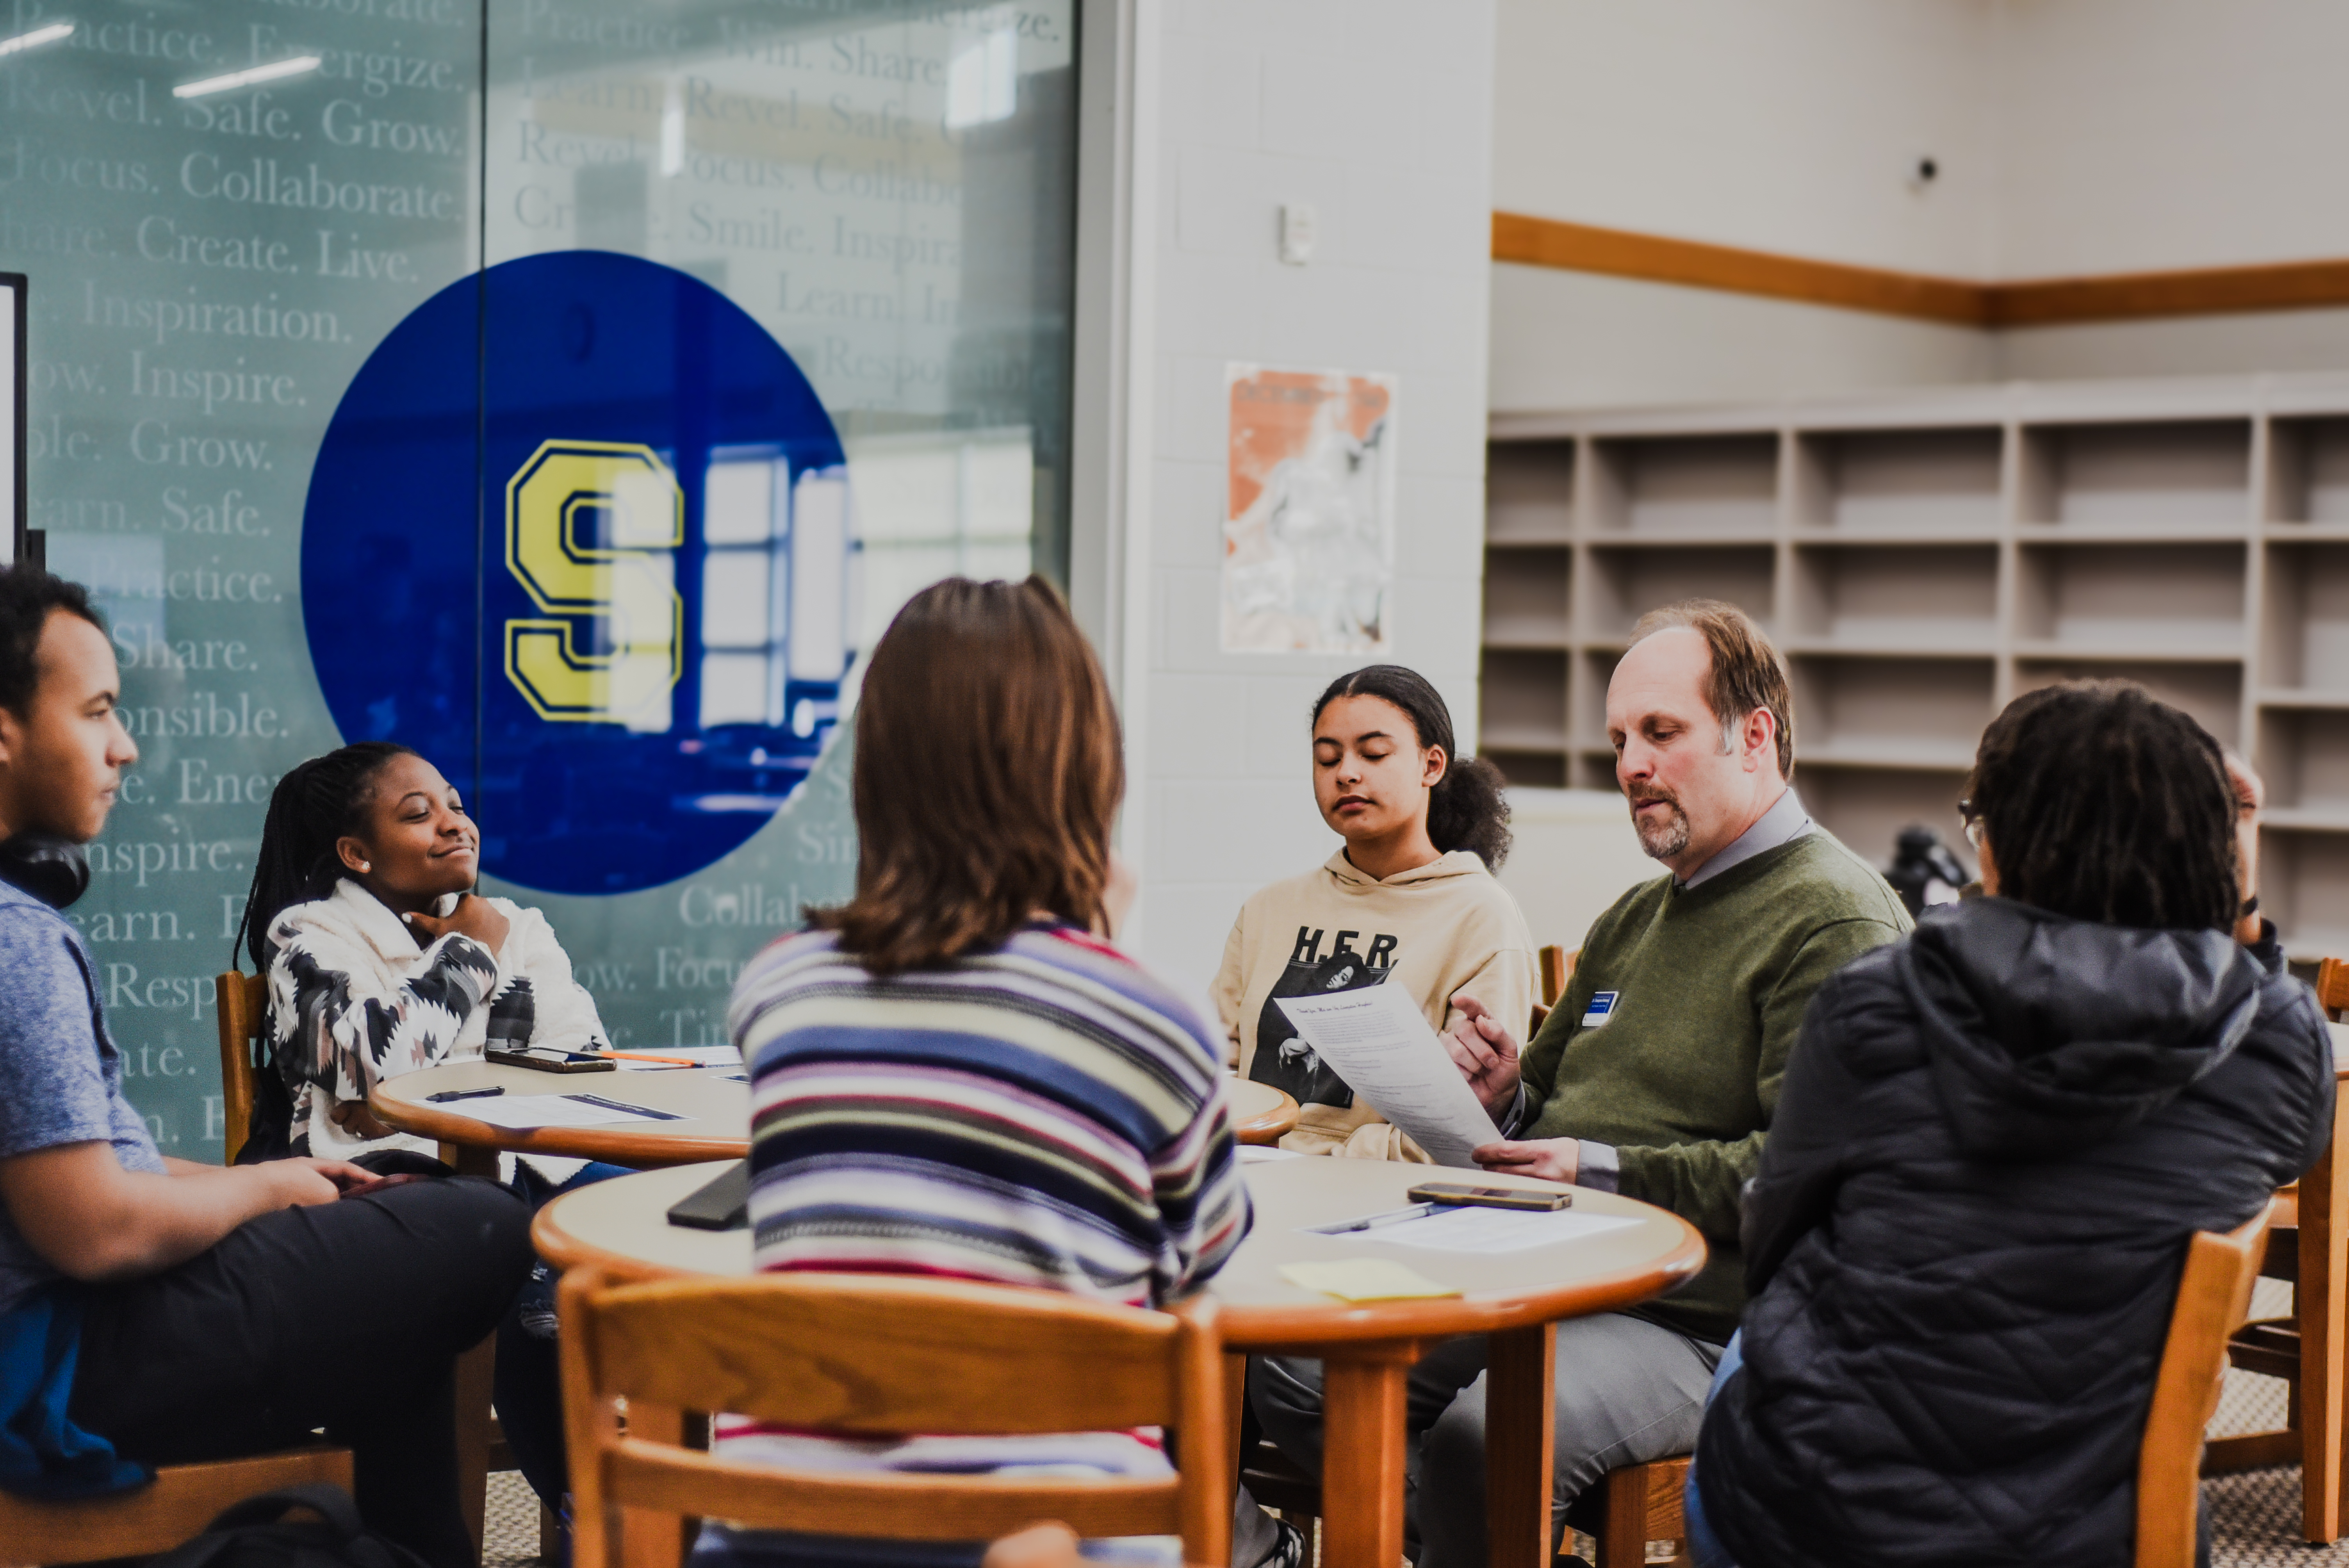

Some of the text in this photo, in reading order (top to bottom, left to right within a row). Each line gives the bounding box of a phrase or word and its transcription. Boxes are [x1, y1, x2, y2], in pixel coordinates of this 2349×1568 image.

[9, 0, 226, 64] Pactice.
[183, 88, 302, 140] Safe.
[321, 98, 464, 157] Grow.
[686, 75, 811, 134] Revel.
[829, 92, 923, 144] Safe.
[180, 151, 465, 224] Collaborate.
[136, 214, 299, 273] Create.
[316, 230, 419, 283] Live.
[687, 198, 815, 257] Smile.
[81, 278, 353, 345] Inspiration.
[777, 269, 906, 323] Learn.
[130, 351, 306, 416] Inspire.
[130, 416, 272, 471] Grow.
[161, 484, 271, 537] Safe.
[89, 551, 283, 604] Practice.
[505, 438, 684, 723] S
[113, 622, 258, 672] Share.
